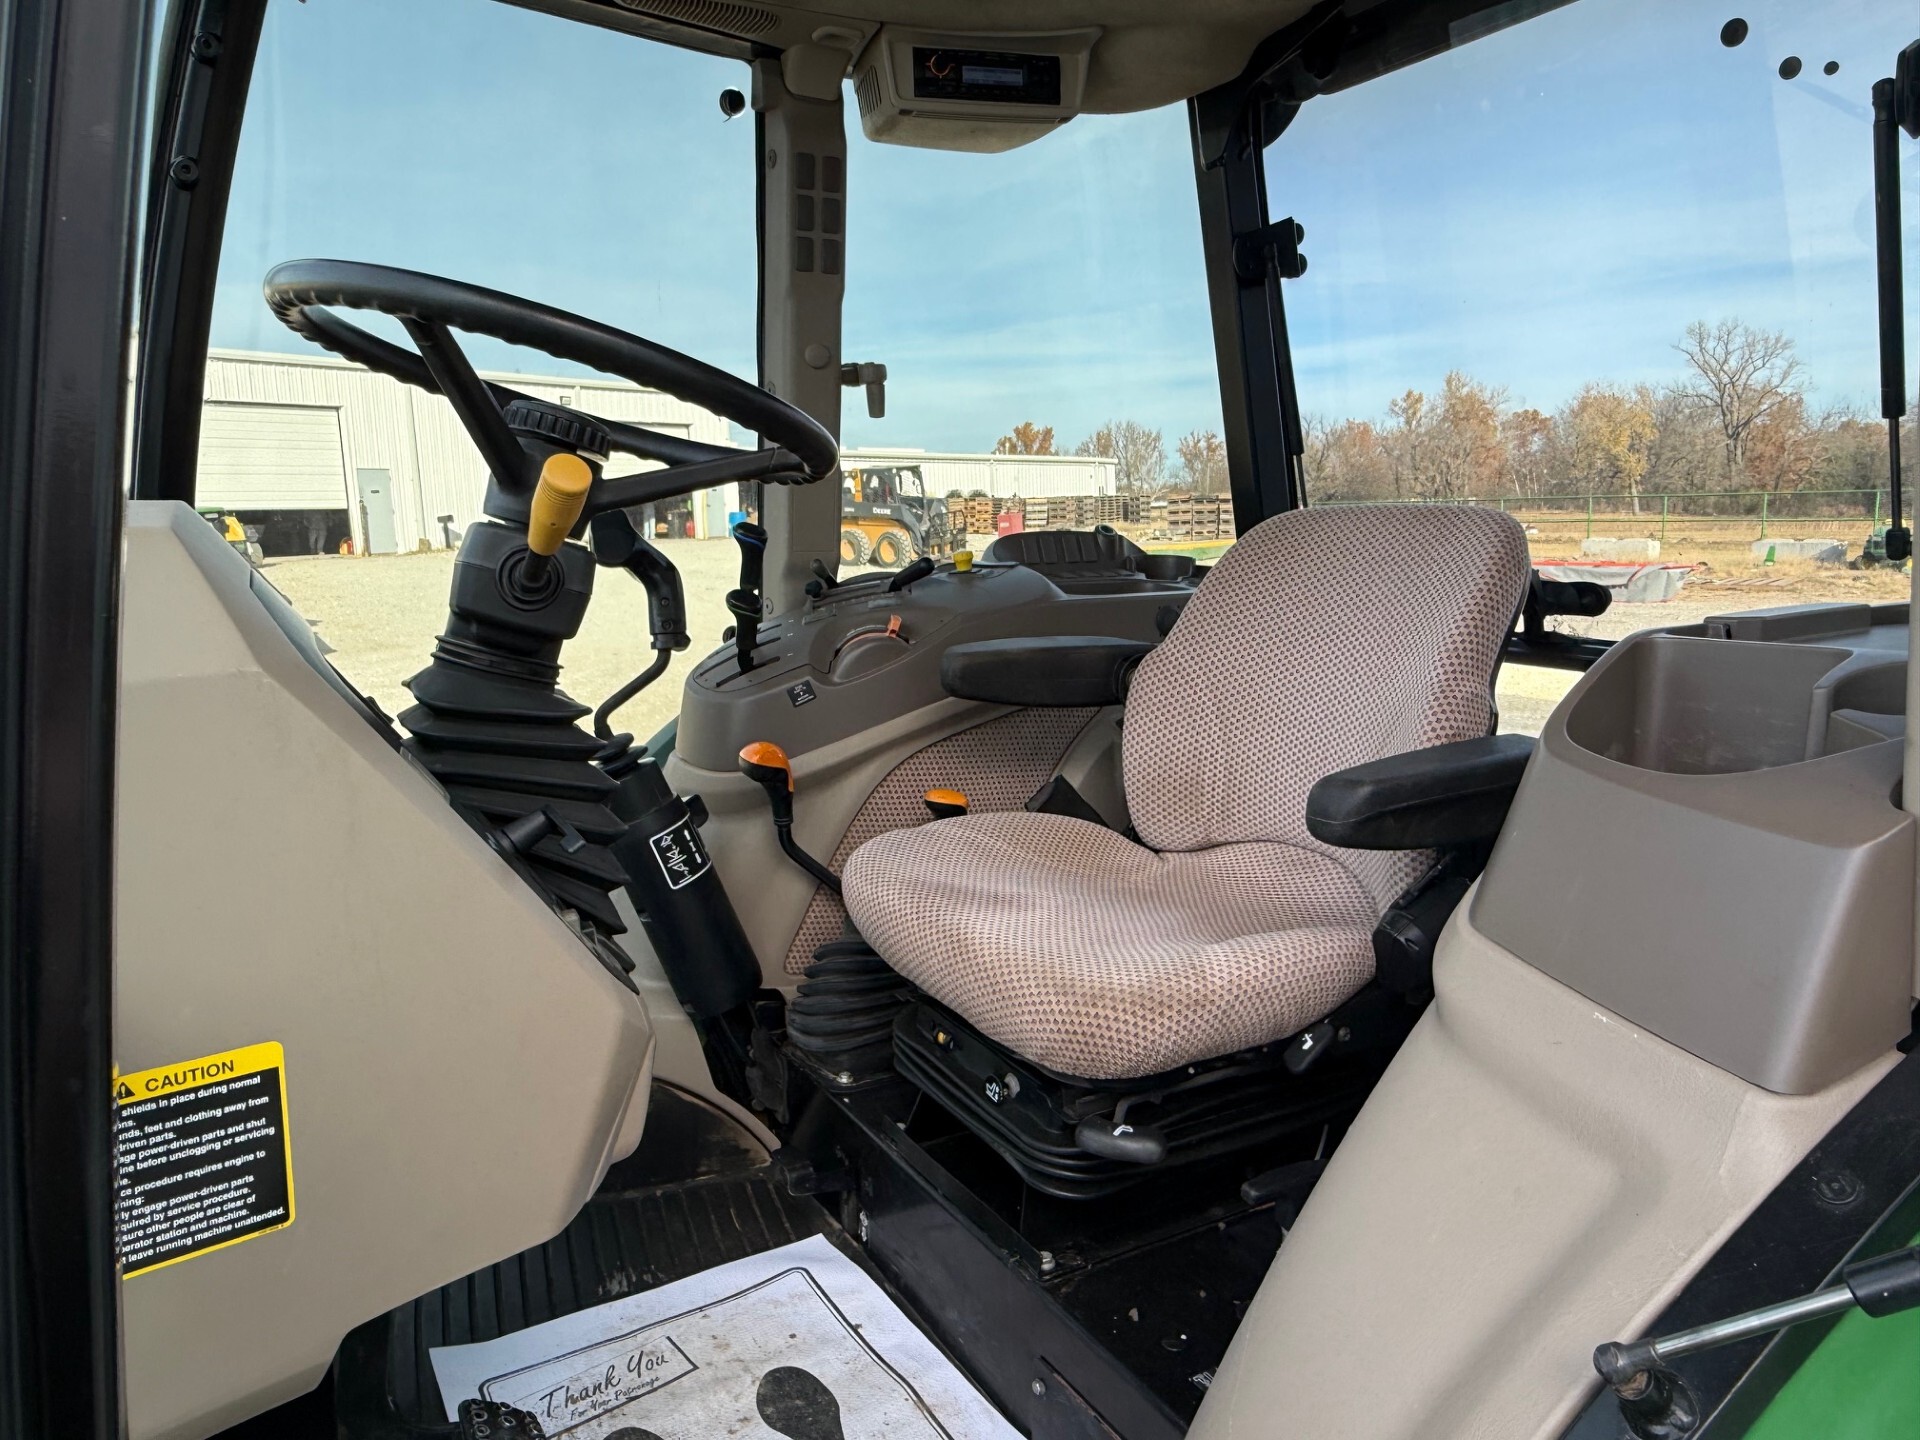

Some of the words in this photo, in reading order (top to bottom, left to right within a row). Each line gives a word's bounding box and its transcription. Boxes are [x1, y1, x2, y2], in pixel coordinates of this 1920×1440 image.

[122, 1102, 156, 1117] shields
[159, 1099, 168, 1108] in
[170, 1092, 196, 1106] place
[198, 1084, 228, 1098] during
[229, 1075, 260, 1090] normal
[145, 1060, 234, 1092] CAUTION
[144, 1122, 163, 1133] feet
[165, 1117, 182, 1128] and
[184, 1108, 222, 1123] clothing
[224, 1102, 246, 1114] away
[248, 1096, 269, 1107] from
[137, 1156, 167, 1170] before
[170, 1142, 221, 1161] unclogging
[223, 1138, 233, 1146] or
[235, 1126, 275, 1143] servicing
[138, 1136, 200, 1160] power-driven
[202, 1129, 226, 1142] parts
[227, 1123, 244, 1134] and
[246, 1117, 266, 1129] shut
[149, 1132, 176, 1145] parts.
[134, 1174, 182, 1194] procedure
[185, 1162, 222, 1179] requires
[224, 1154, 254, 1167] engine
[132, 1201, 167, 1216] engage
[169, 1182, 229, 1206] power-driven
[231, 1175, 254, 1188] parts
[154, 1212, 165, 1221] by
[167, 1202, 201, 1216] service
[203, 1187, 251, 1208] procedure.
[122, 1230, 144, 1242] sure
[146, 1221, 171, 1234] other
[173, 1211, 204, 1228] people
[206, 1206, 221, 1216] are
[223, 1198, 245, 1211] clear
[247, 1194, 256, 1203] of
[128, 1248, 154, 1262] leave
[156, 1237, 192, 1253] running
[194, 1224, 232, 1241] machine
[235, 1206, 285, 1229] unattended.
[156, 1227, 188, 1242] station
[190, 1220, 207, 1232] and
[209, 1208, 250, 1225] machine.
[539, 1364, 621, 1418] Thank
[627, 1350, 669, 1378] You
[614, 1376, 660, 1401] Patronage
